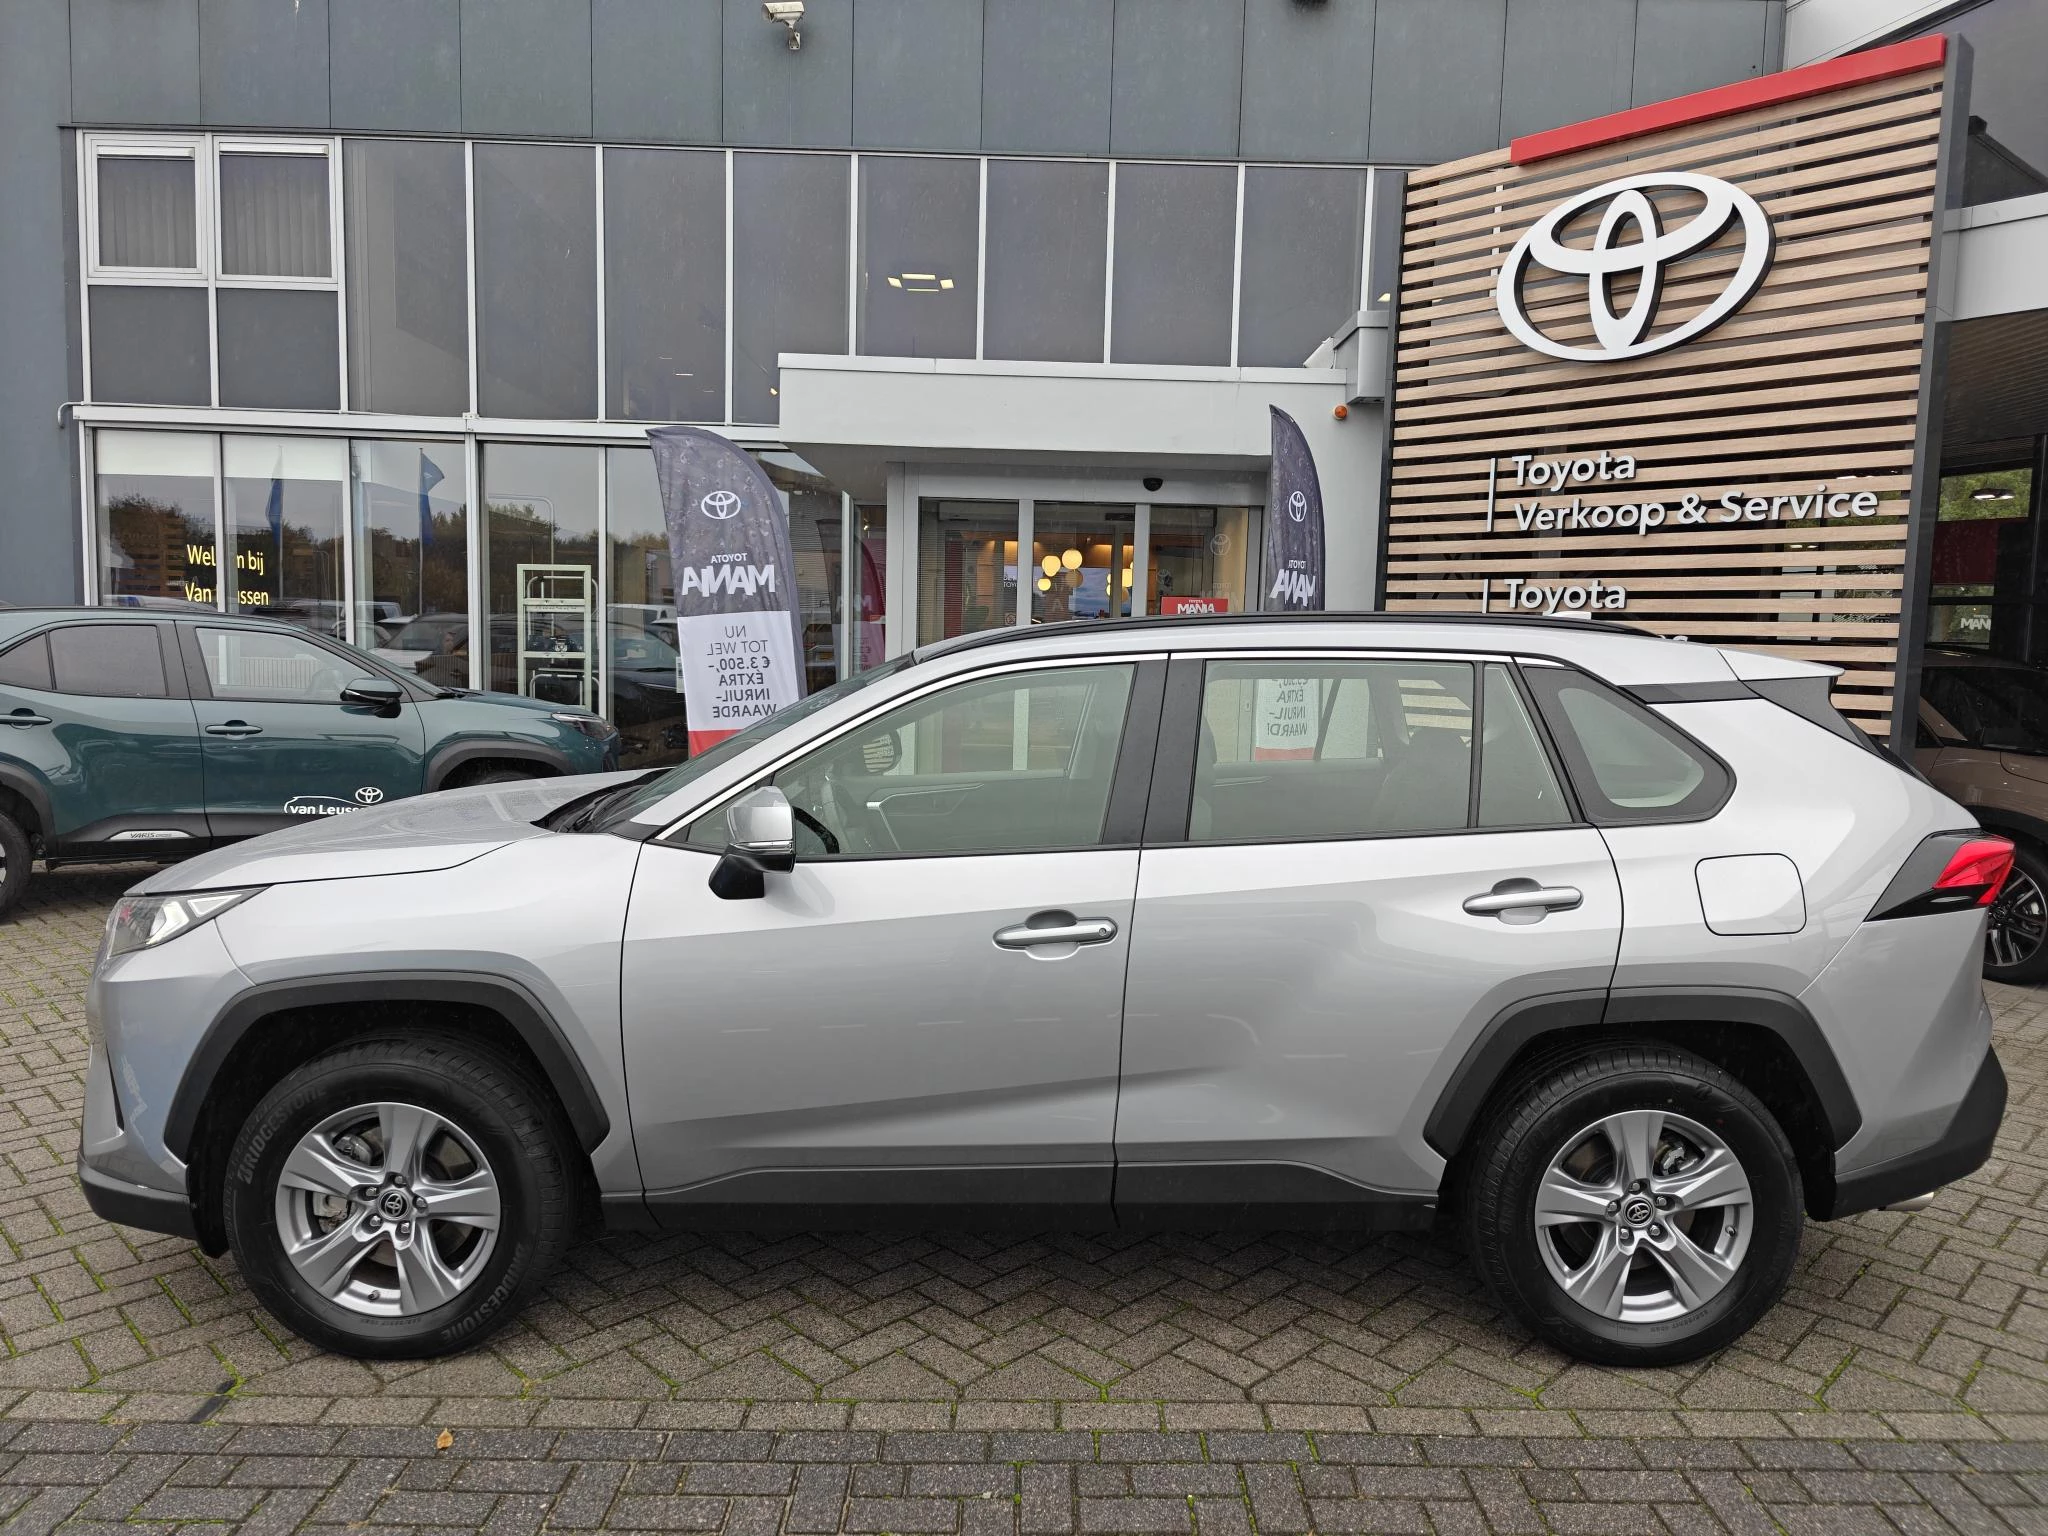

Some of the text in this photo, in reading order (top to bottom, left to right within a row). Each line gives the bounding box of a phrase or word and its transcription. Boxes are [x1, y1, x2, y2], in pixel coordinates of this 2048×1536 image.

[1511, 450, 1637, 493] Toyota
[1513, 484, 1879, 536] Verkoop & Service
[186, 543, 264, 576] Welm bij
[184, 582, 269, 606] Van ssen
[1177, 603, 1215, 615] MANIA
[1504, 577, 1628, 615] Toyota
[289, 805, 316, 815] van
